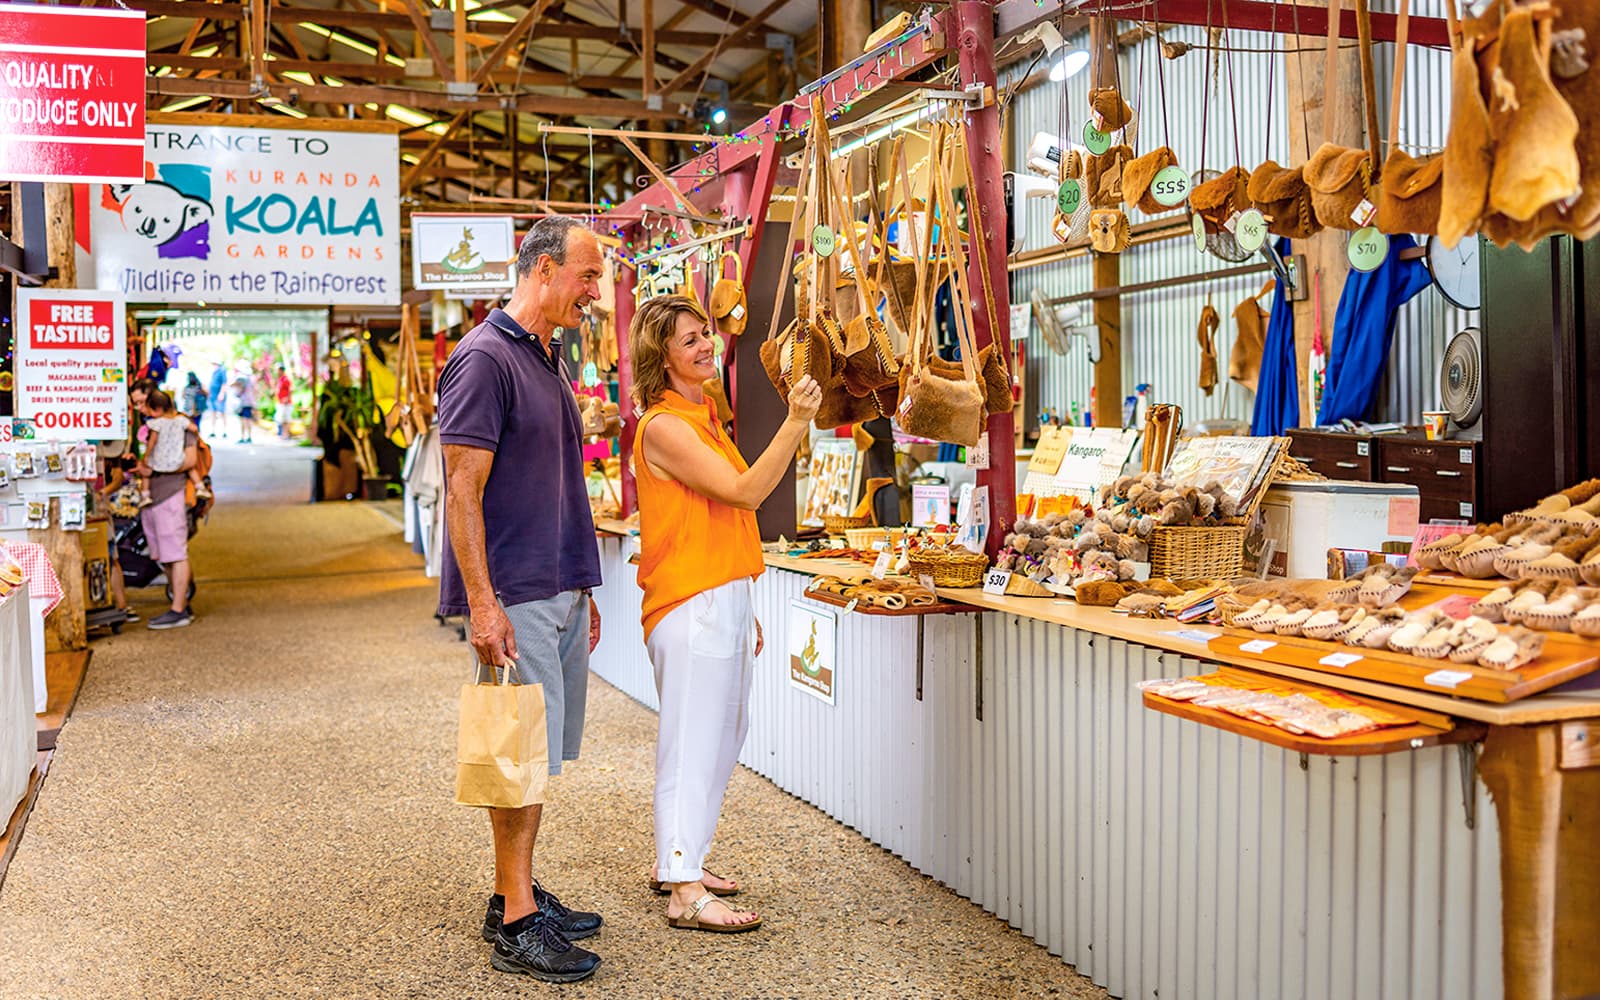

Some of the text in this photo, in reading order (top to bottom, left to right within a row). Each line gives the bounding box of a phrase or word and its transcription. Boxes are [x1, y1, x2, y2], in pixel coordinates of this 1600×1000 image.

[5, 61, 94, 90] QUALITY
[83, 100, 137, 128] ONLY
[288, 137, 329, 156] TO
[226, 168, 381, 188] KURANDA
[1155, 179, 1187, 195] $55
[1059, 189, 1080, 206] $20
[225, 193, 384, 237] KOALA
[226, 243, 384, 261] GARDENS
[1357, 243, 1377, 256] $70
[202, 269, 222, 292] in
[230, 272, 266, 294] the
[271, 270, 387, 296] Rainforest
[425, 272, 506, 283] The Kangaroo Shop
[51, 305, 94, 323] FREE
[34, 325, 111, 344] TASTING
[25, 359, 118, 369] Local quality produce
[26, 385, 43, 393] BEEF
[31, 396, 113, 404] DRIED TROPICAL FRUIT
[34, 411, 113, 429] COOKIES
[988, 573, 1007, 588] $30
